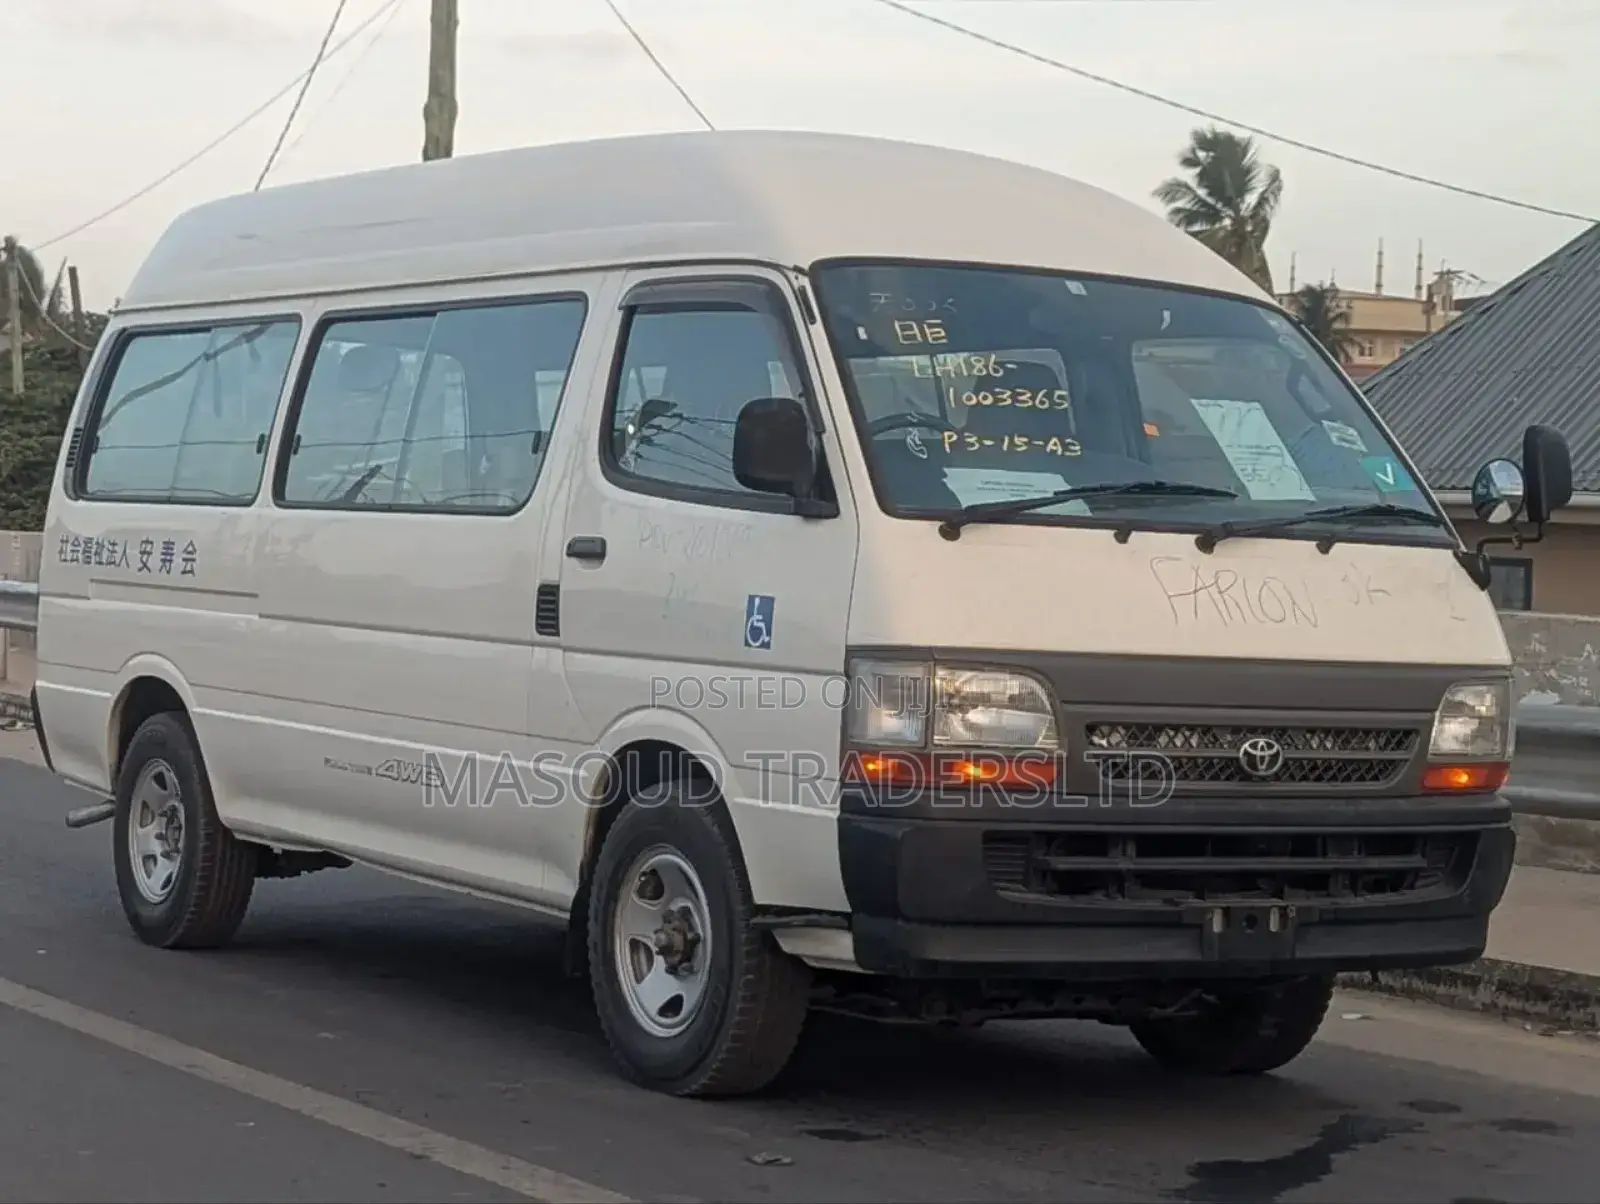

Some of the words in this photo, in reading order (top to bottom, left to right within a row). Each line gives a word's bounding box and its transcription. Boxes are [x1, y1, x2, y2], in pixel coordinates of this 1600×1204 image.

[949, 387, 1069, 410] 1003365
[943, 431, 1082, 456] P3-15-A3
[137, 536, 198, 577] 安寿会
